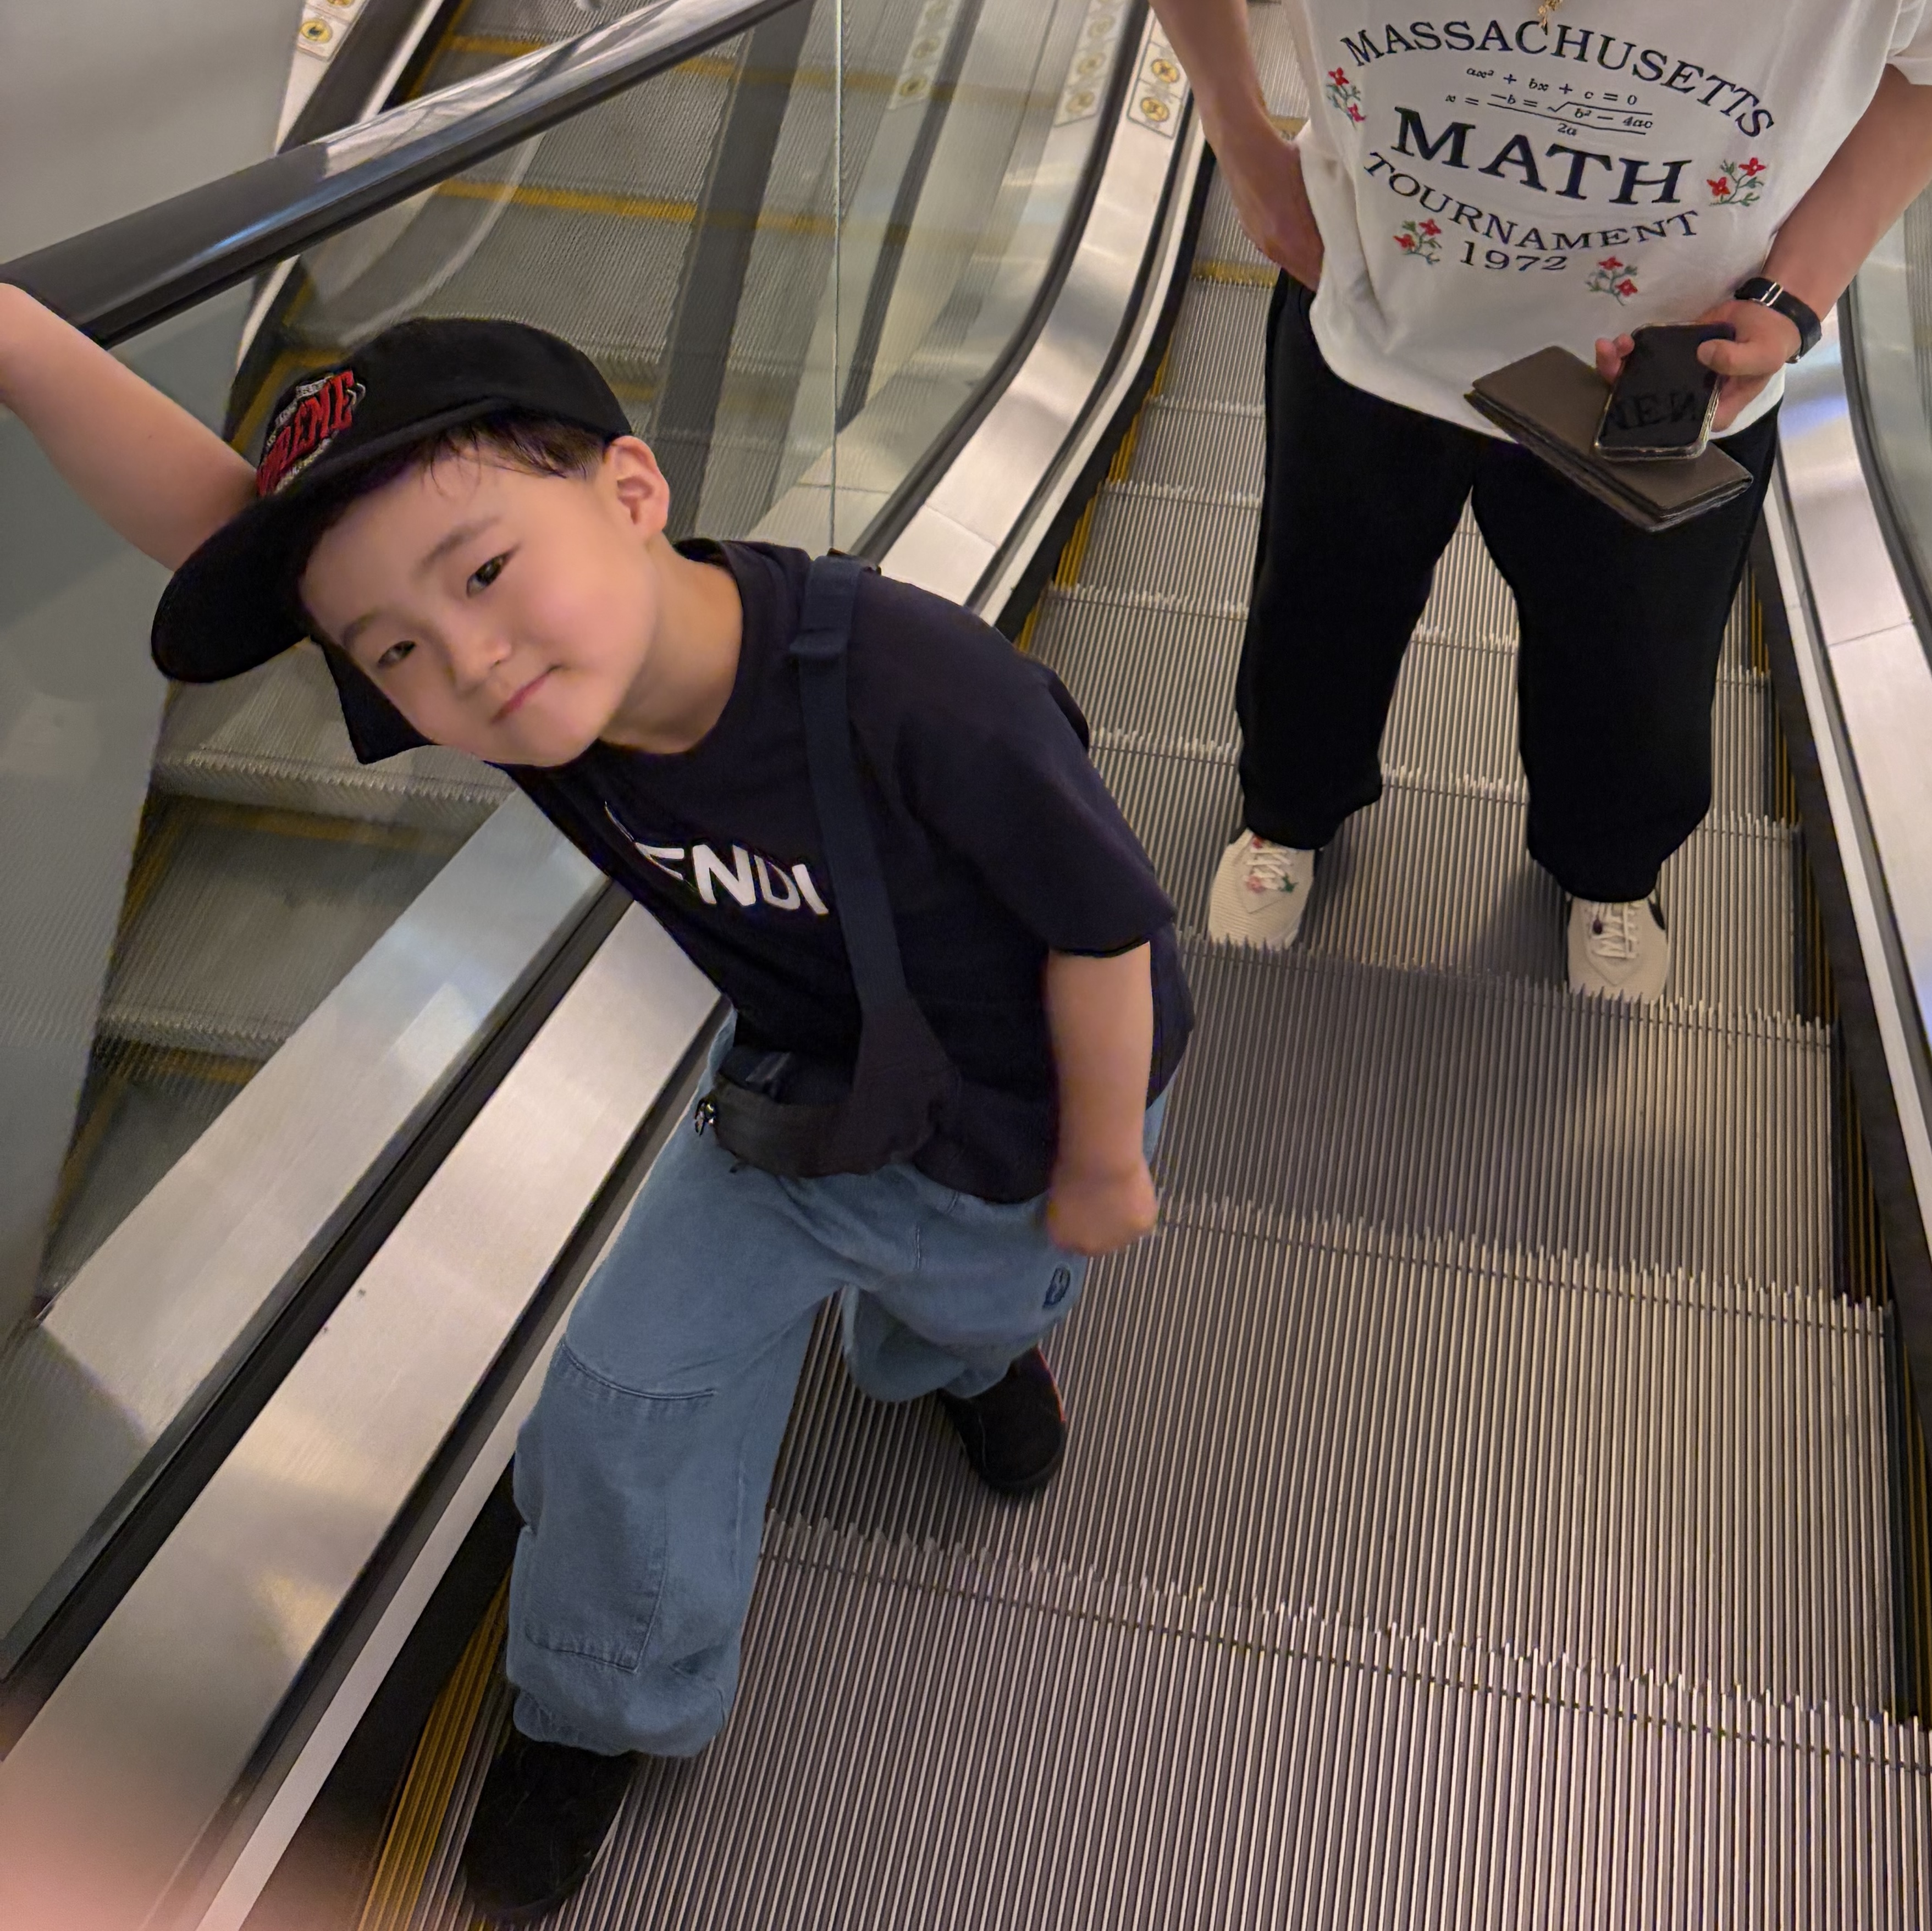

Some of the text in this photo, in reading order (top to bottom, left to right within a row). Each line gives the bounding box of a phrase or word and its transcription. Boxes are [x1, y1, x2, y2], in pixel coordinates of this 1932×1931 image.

[1340, 20, 1774, 137] MASSACHUSETTS
[1364, 152, 1698, 251] TOURNAMENT
[1390, 106, 1692, 204] MATH
[1460, 241, 1567, 271] 1972
[605, 801, 829, 915] NDI
